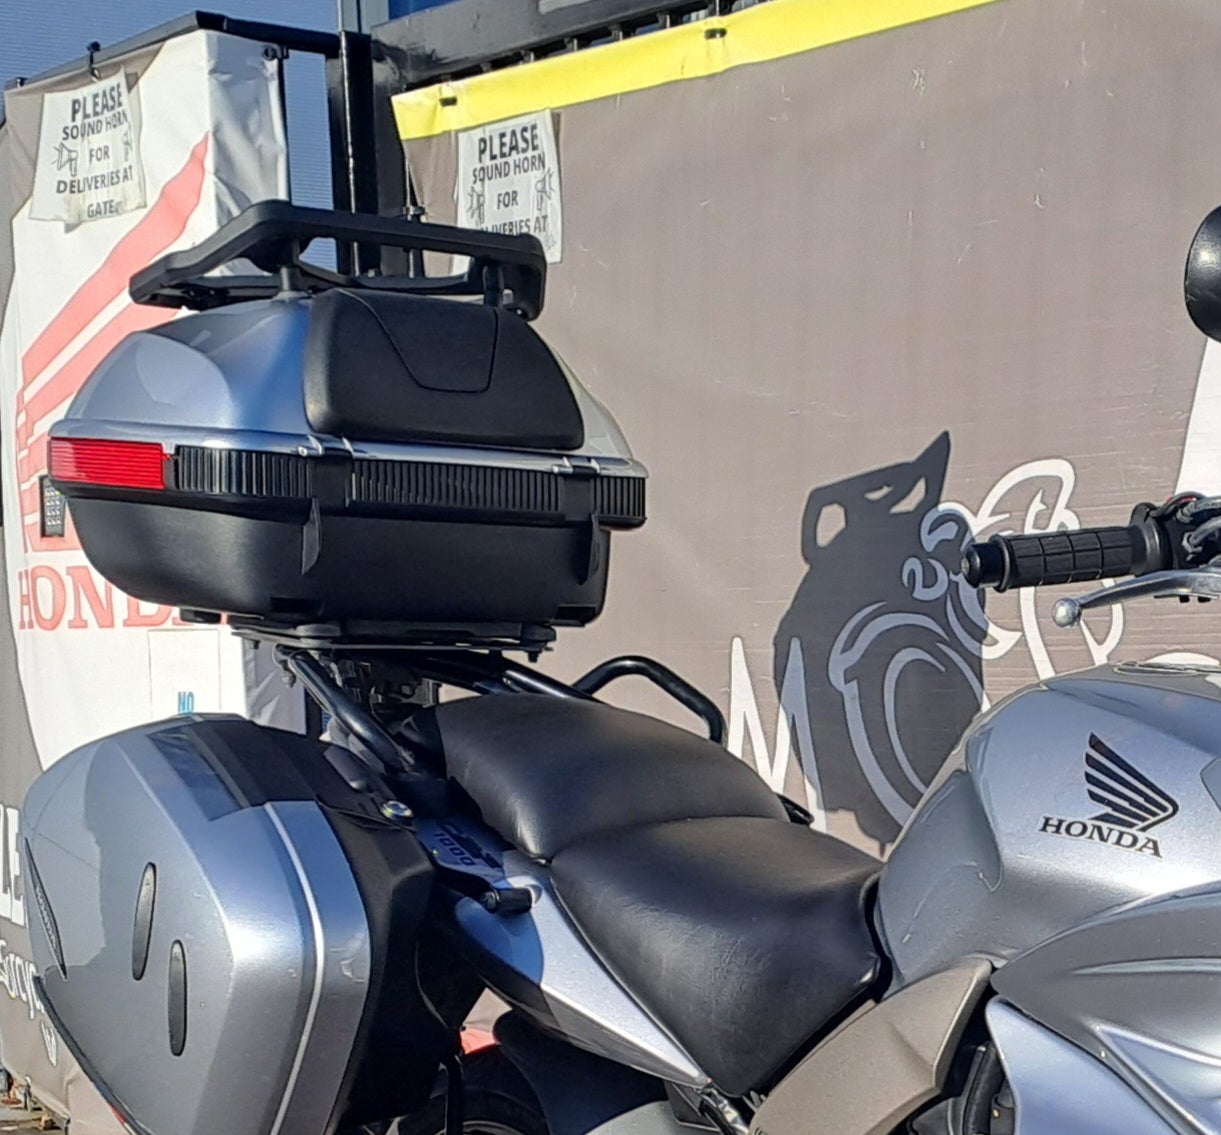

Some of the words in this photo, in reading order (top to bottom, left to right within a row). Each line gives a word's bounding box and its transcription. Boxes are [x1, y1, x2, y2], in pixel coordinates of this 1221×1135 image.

[71, 82, 123, 122] PLEASE
[62, 119, 103, 141] SOUND
[105, 108, 128, 131] HORN
[89, 145, 110, 163] FOR
[478, 124, 540, 163] PLEASE
[56, 170, 121, 194] DELIVERIES
[122, 165, 134, 182] AT
[472, 161, 511, 184] SOUND
[514, 152, 546, 175] HORN
[87, 199, 115, 218] GATE
[497, 190, 519, 209] FOR
[534, 215, 549, 233] AT
[18, 565, 228, 631] HON
[433, 832, 477, 866] 1000
[1039, 815, 1163, 859] HONDA
